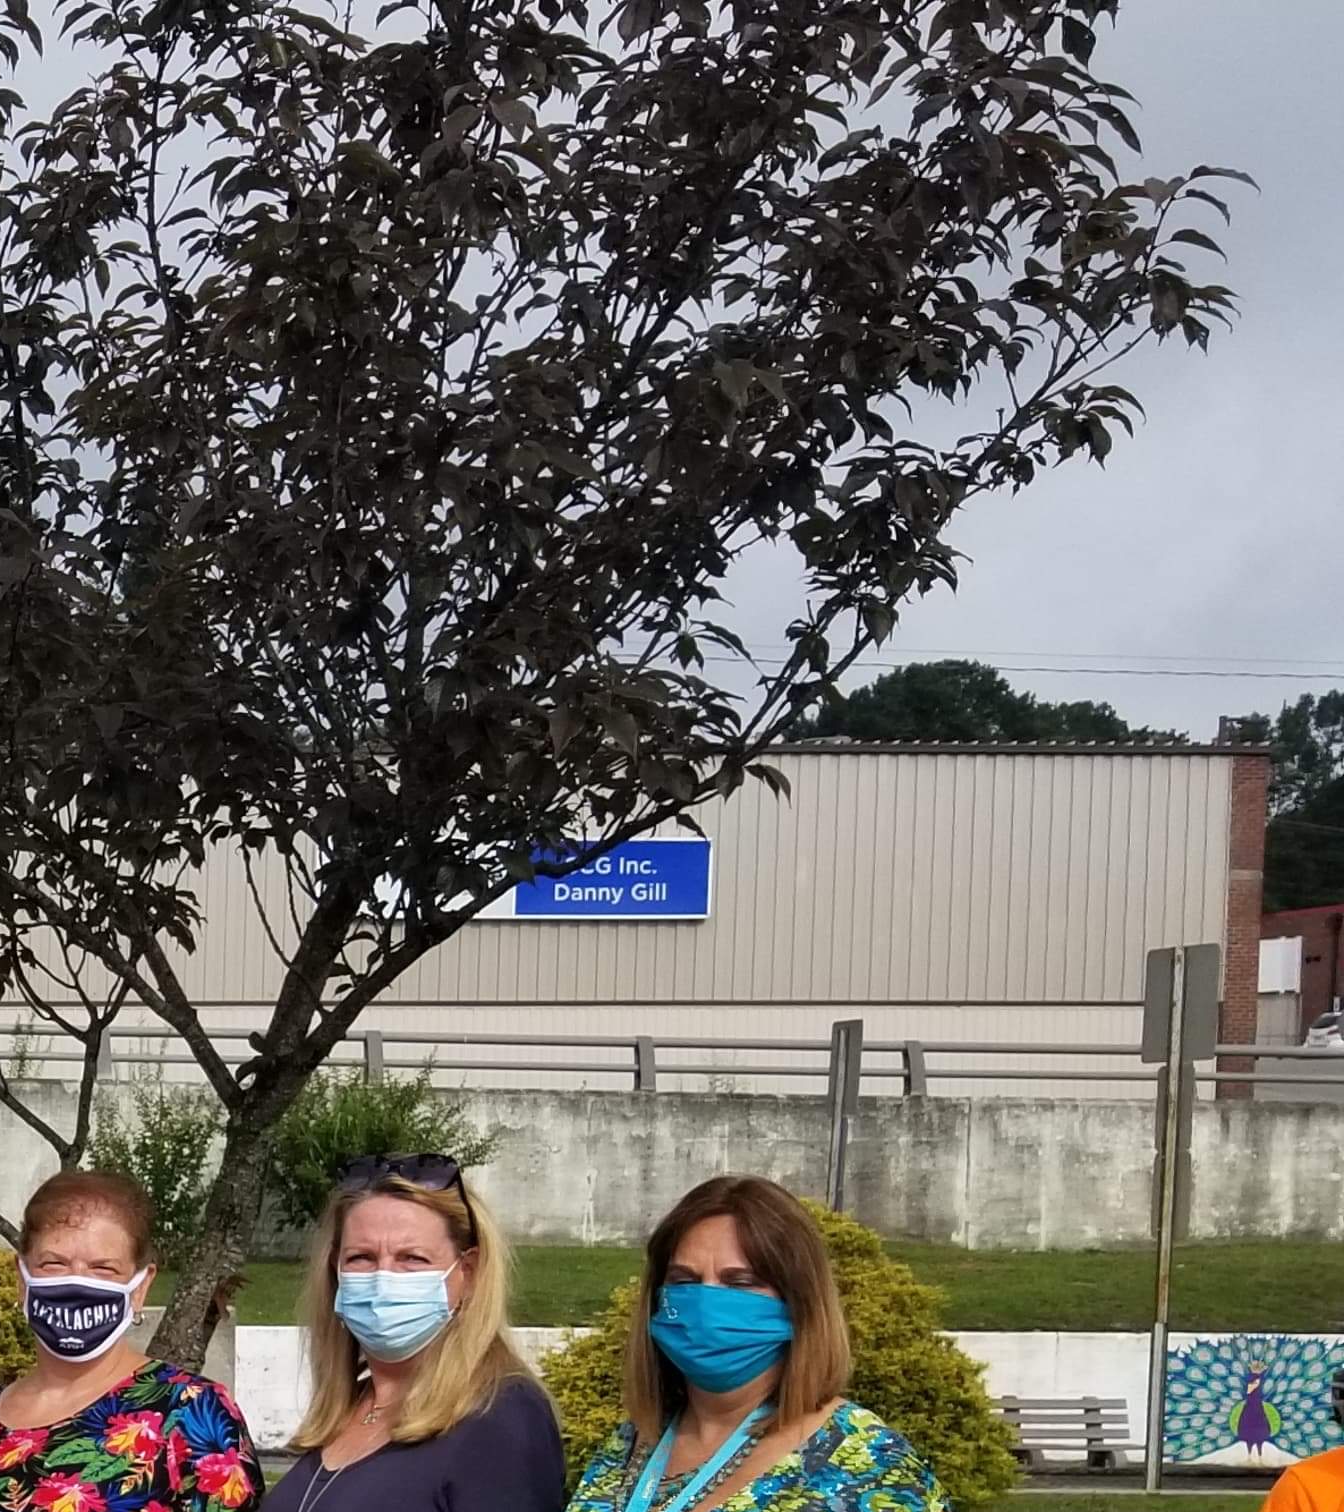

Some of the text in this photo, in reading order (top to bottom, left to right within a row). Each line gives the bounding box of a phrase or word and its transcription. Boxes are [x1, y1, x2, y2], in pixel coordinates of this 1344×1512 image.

[619, 856, 657, 874] Inc.
[554, 883, 667, 904] Danny Gill
